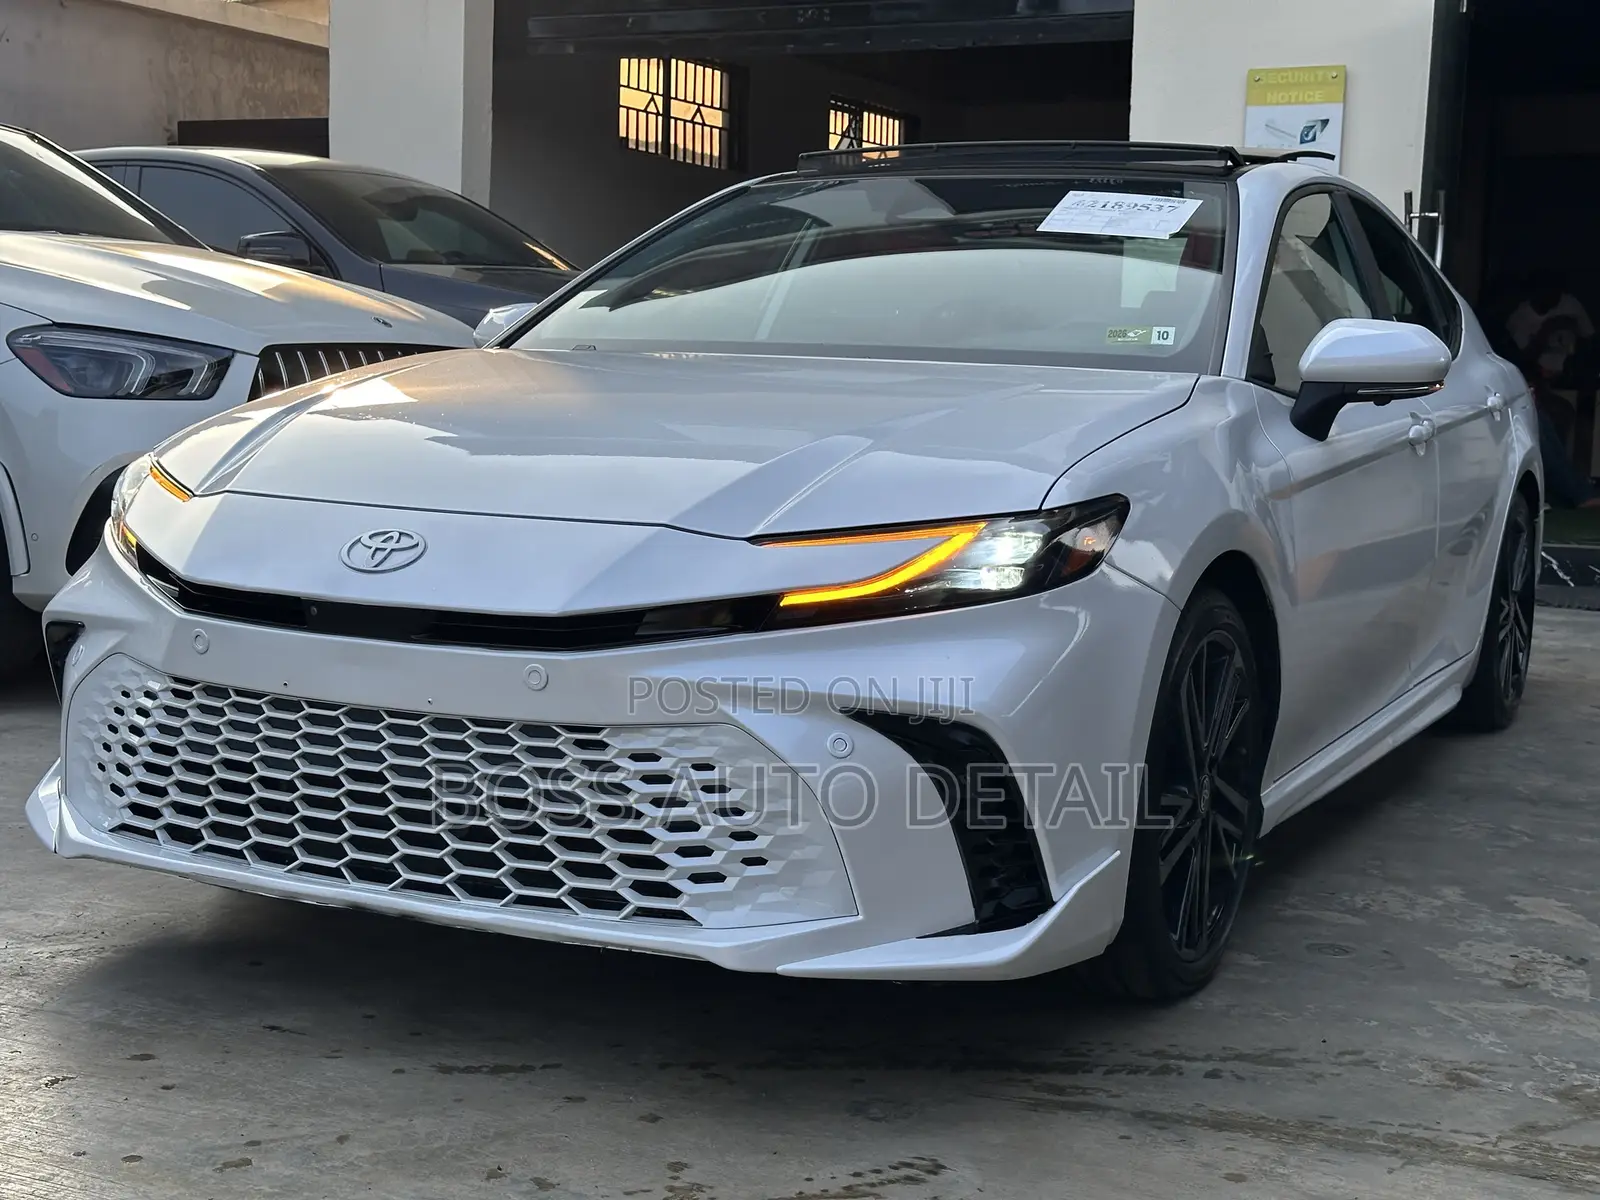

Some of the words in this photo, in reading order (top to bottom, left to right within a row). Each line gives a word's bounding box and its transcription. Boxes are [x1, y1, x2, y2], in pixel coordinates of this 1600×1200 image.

[1266, 90, 1325, 103] NOTICE
[1108, 329, 1128, 338] 2026
[1156, 330, 1170, 341] 10
